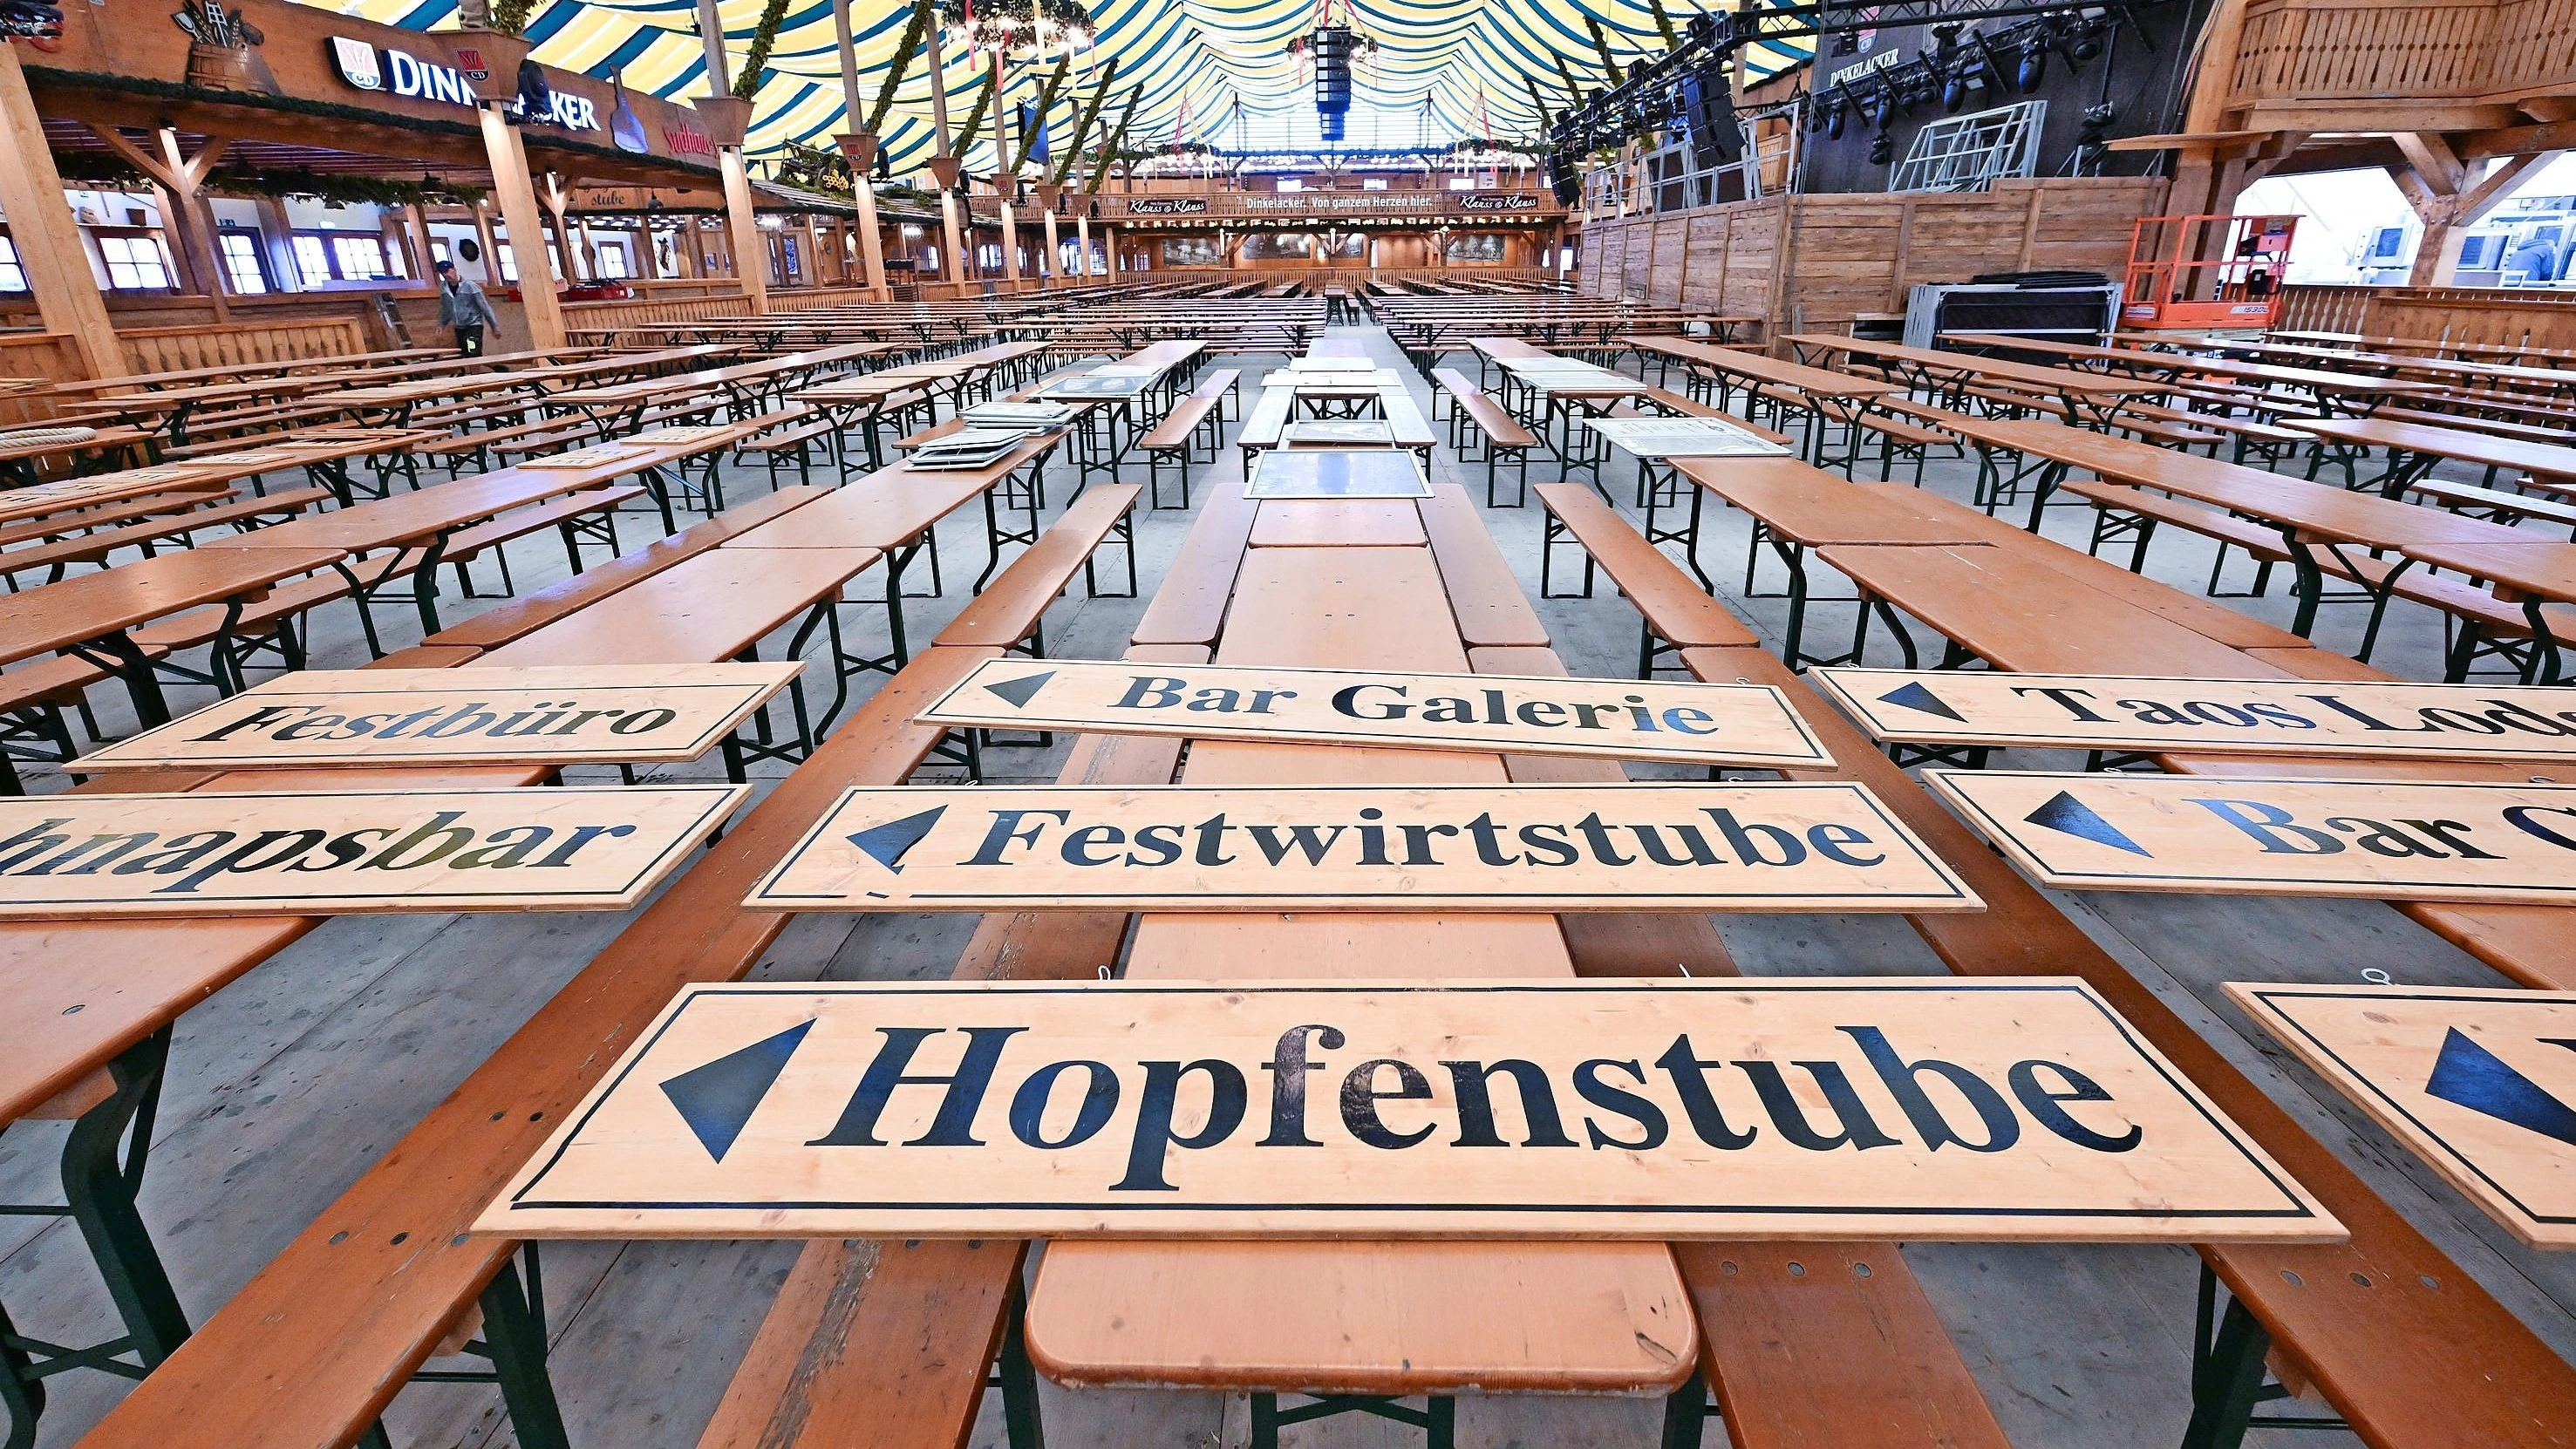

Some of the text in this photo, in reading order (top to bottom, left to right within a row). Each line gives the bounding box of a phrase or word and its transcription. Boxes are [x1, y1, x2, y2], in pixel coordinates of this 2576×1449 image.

[1861, 38, 1871, 50] CD
[591, 190, 625, 206] stube
[1129, 200, 1162, 214] Klauss
[1173, 199, 1205, 213] Klauss
[1312, 197, 1329, 207] Von
[1332, 197, 1370, 209] ganzem
[1373, 195, 1407, 207] Herzen
[1460, 195, 1493, 209] Klauss
[1504, 194, 1537, 208] Klauss
[181, 701, 678, 744] Festbüro
[1109, 675, 1720, 736] Bar Galerie
[2009, 685, 2576, 738] Taos Lod
[955, 807, 1887, 867] Festwirtstube
[2181, 798, 2509, 860] Bar
[803, 1024, 2143, 1192] Hopfenstube
